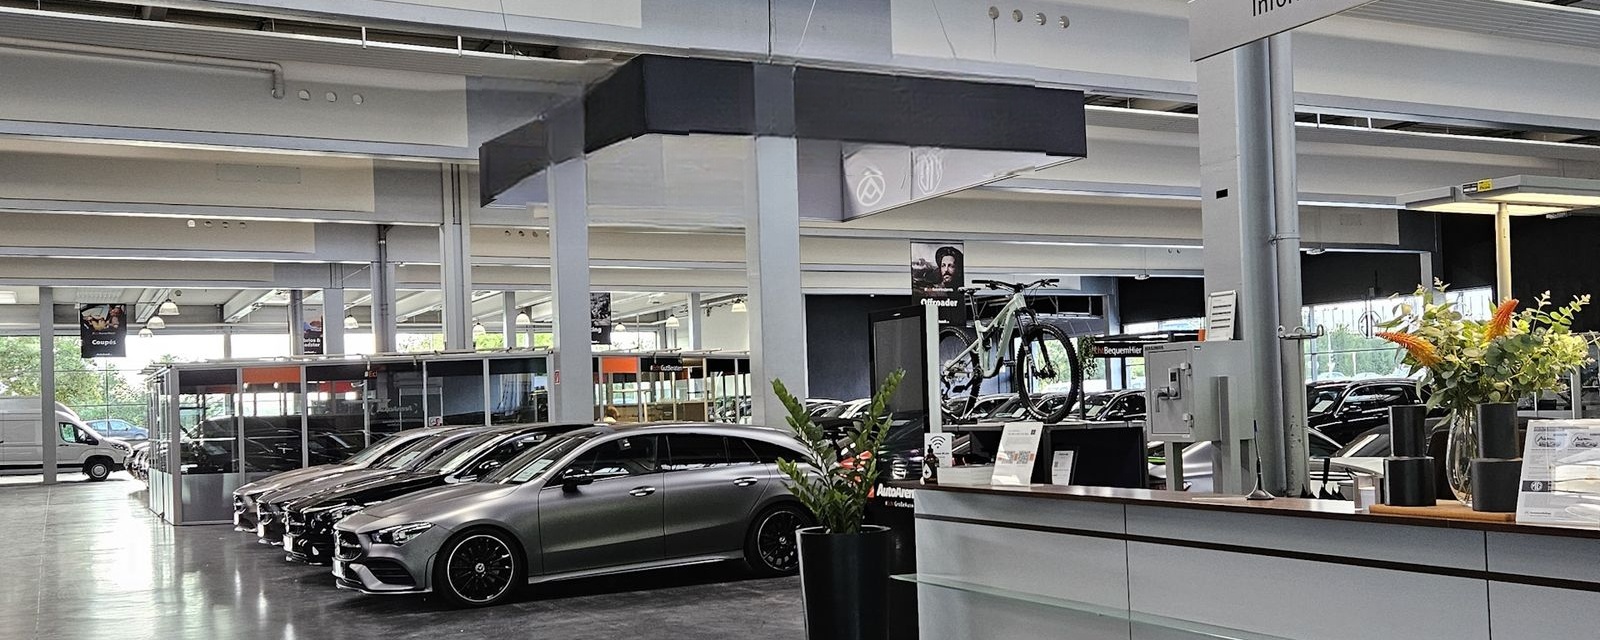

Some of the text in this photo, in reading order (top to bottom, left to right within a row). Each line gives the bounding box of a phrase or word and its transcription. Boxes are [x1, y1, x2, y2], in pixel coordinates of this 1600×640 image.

[920, 298, 958, 307] Offroader
[1094, 346, 1143, 356] chtBequemHier
[876, 483, 915, 499] AutoAren
